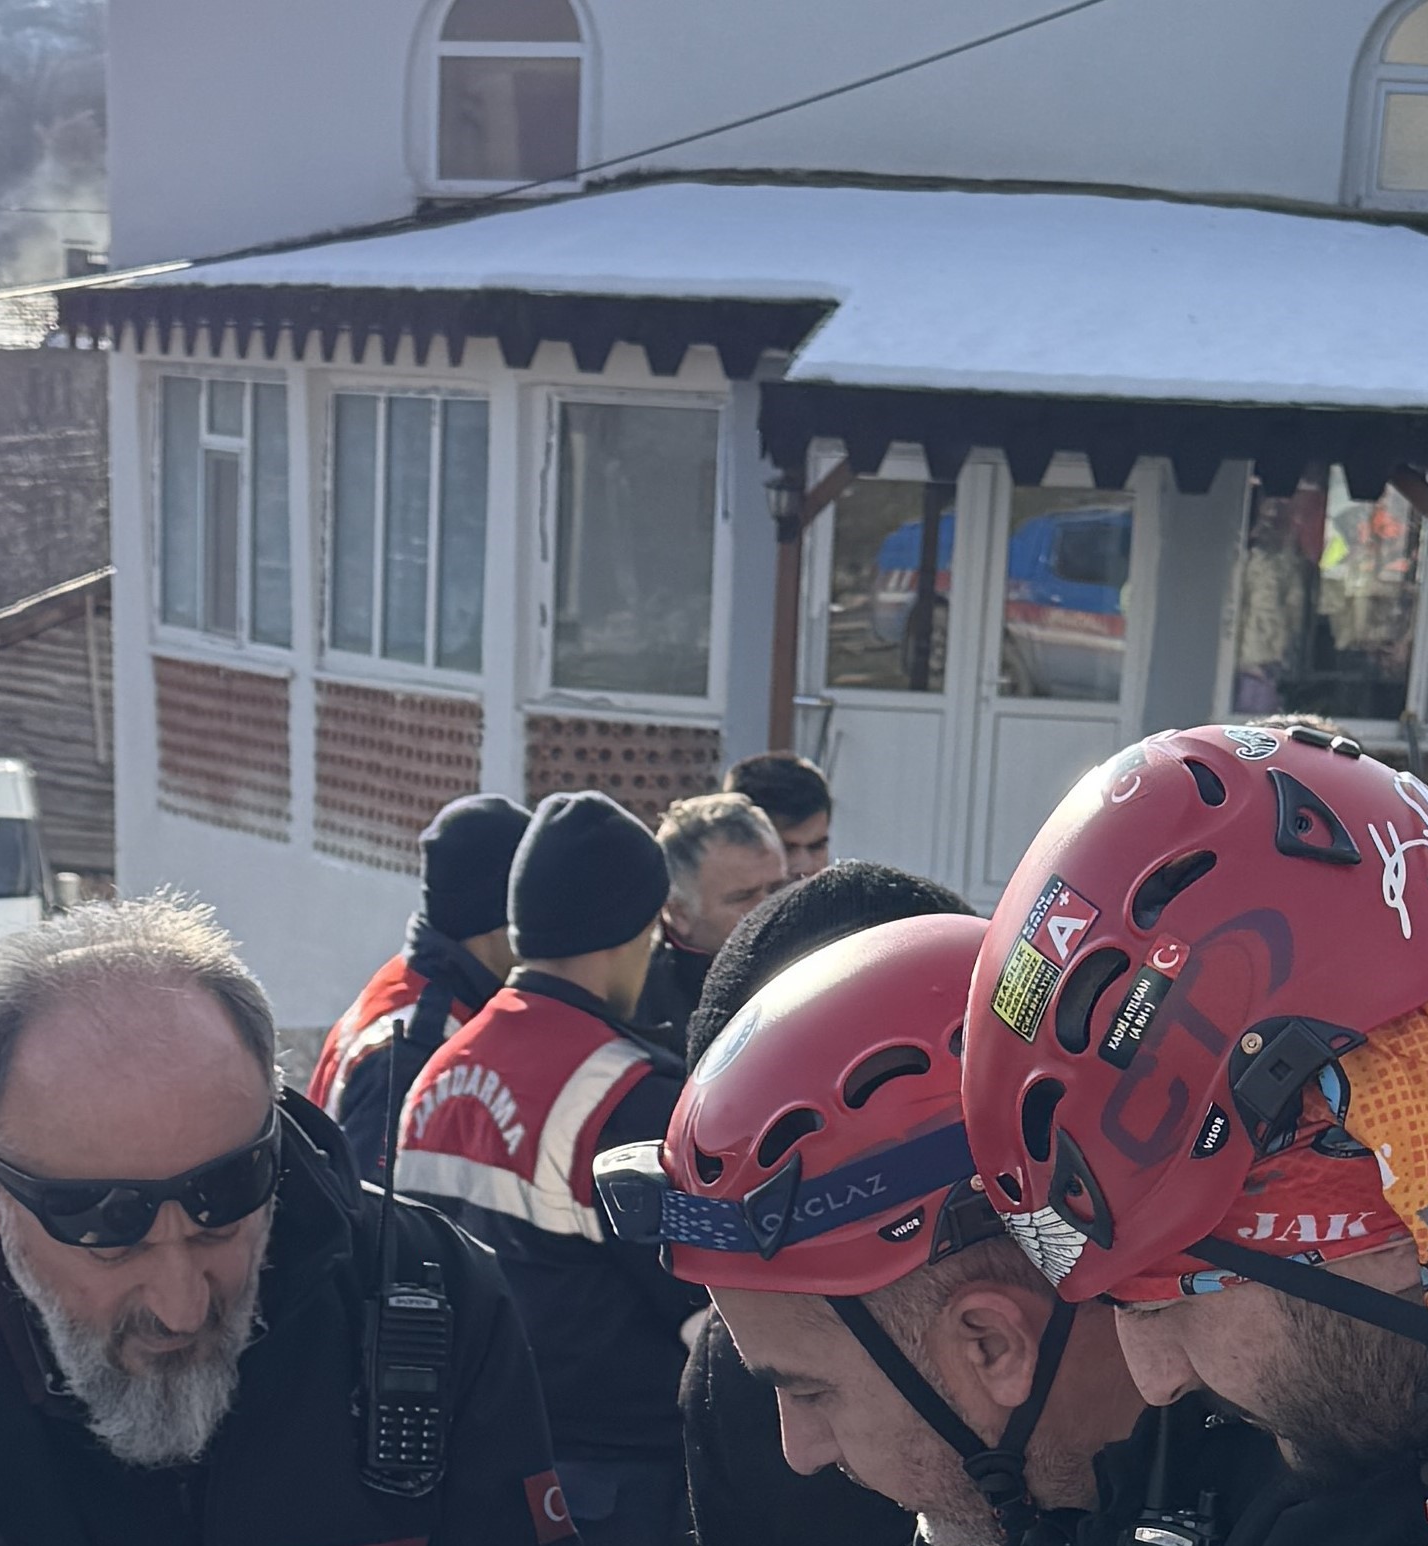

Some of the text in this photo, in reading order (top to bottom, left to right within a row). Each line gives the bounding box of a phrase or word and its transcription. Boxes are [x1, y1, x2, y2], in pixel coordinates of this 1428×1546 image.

[1123, 978, 1152, 1021] ATILKAN
[1202, 1115, 1226, 1151] VISOR
[891, 1216, 921, 1239] VISOR
[1236, 1210, 1377, 1243] JAK
